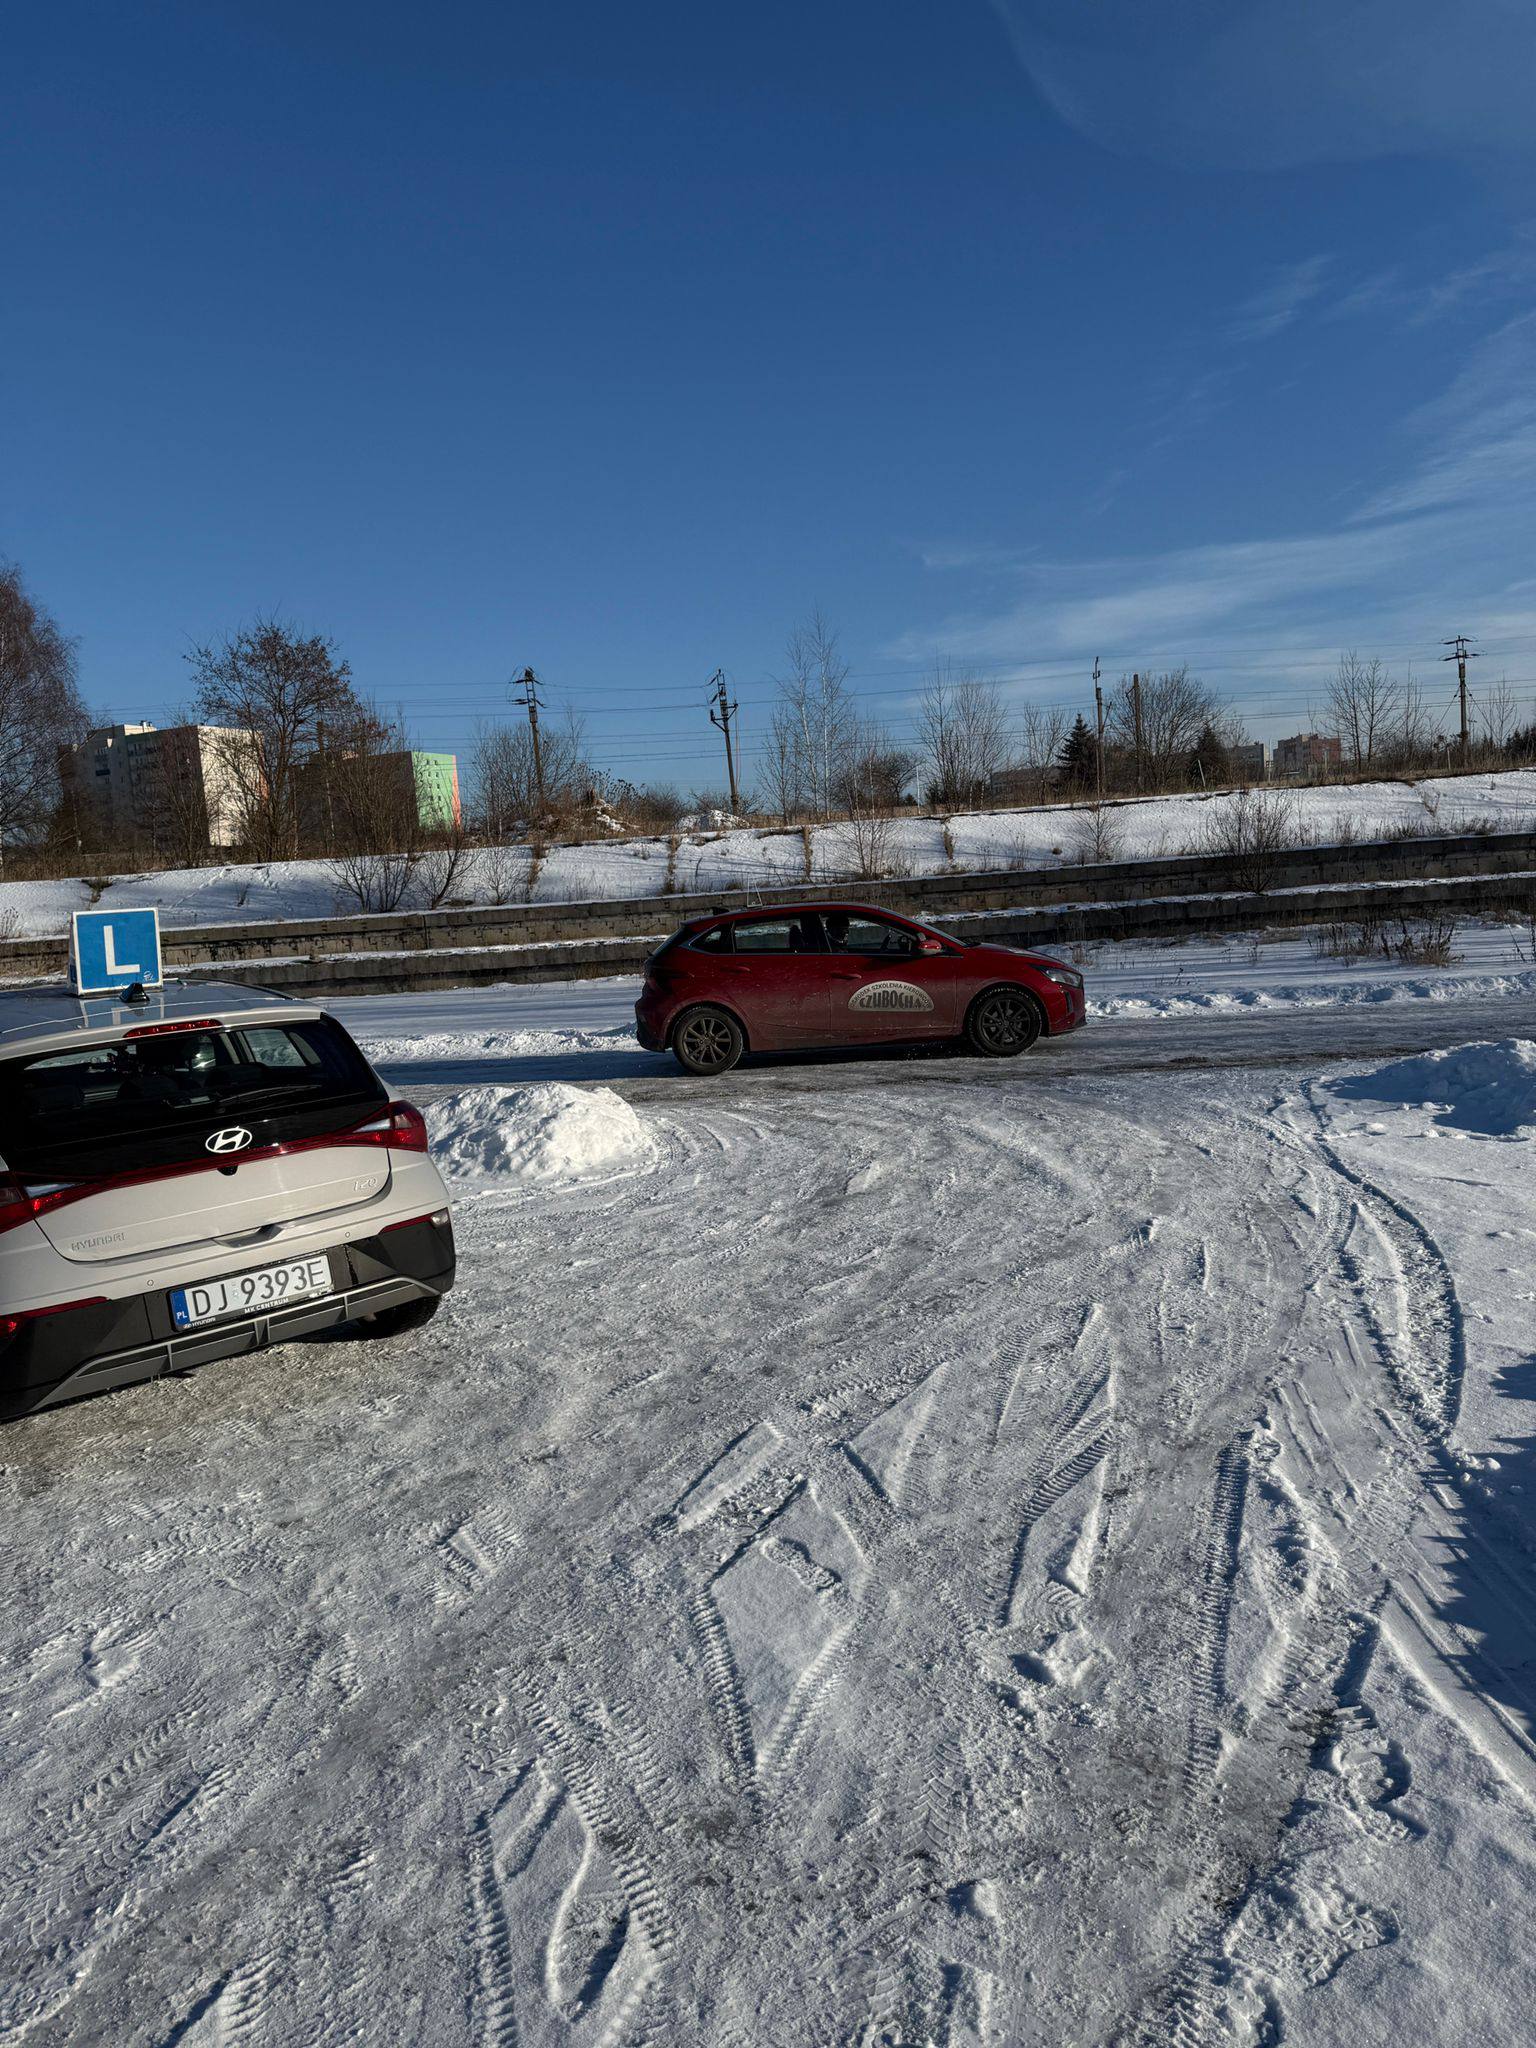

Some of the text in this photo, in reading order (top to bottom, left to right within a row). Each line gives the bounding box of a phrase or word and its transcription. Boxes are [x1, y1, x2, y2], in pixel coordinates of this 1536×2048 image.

[103, 925, 140, 976] L
[860, 990, 922, 1008] CZUBOCHA
[71, 1232, 125, 1251] HYUNDAI
[192, 1259, 325, 1317] DJ 9393E
[244, 1298, 289, 1314] MK CENTRUM
[177, 1311, 187, 1320] PL
